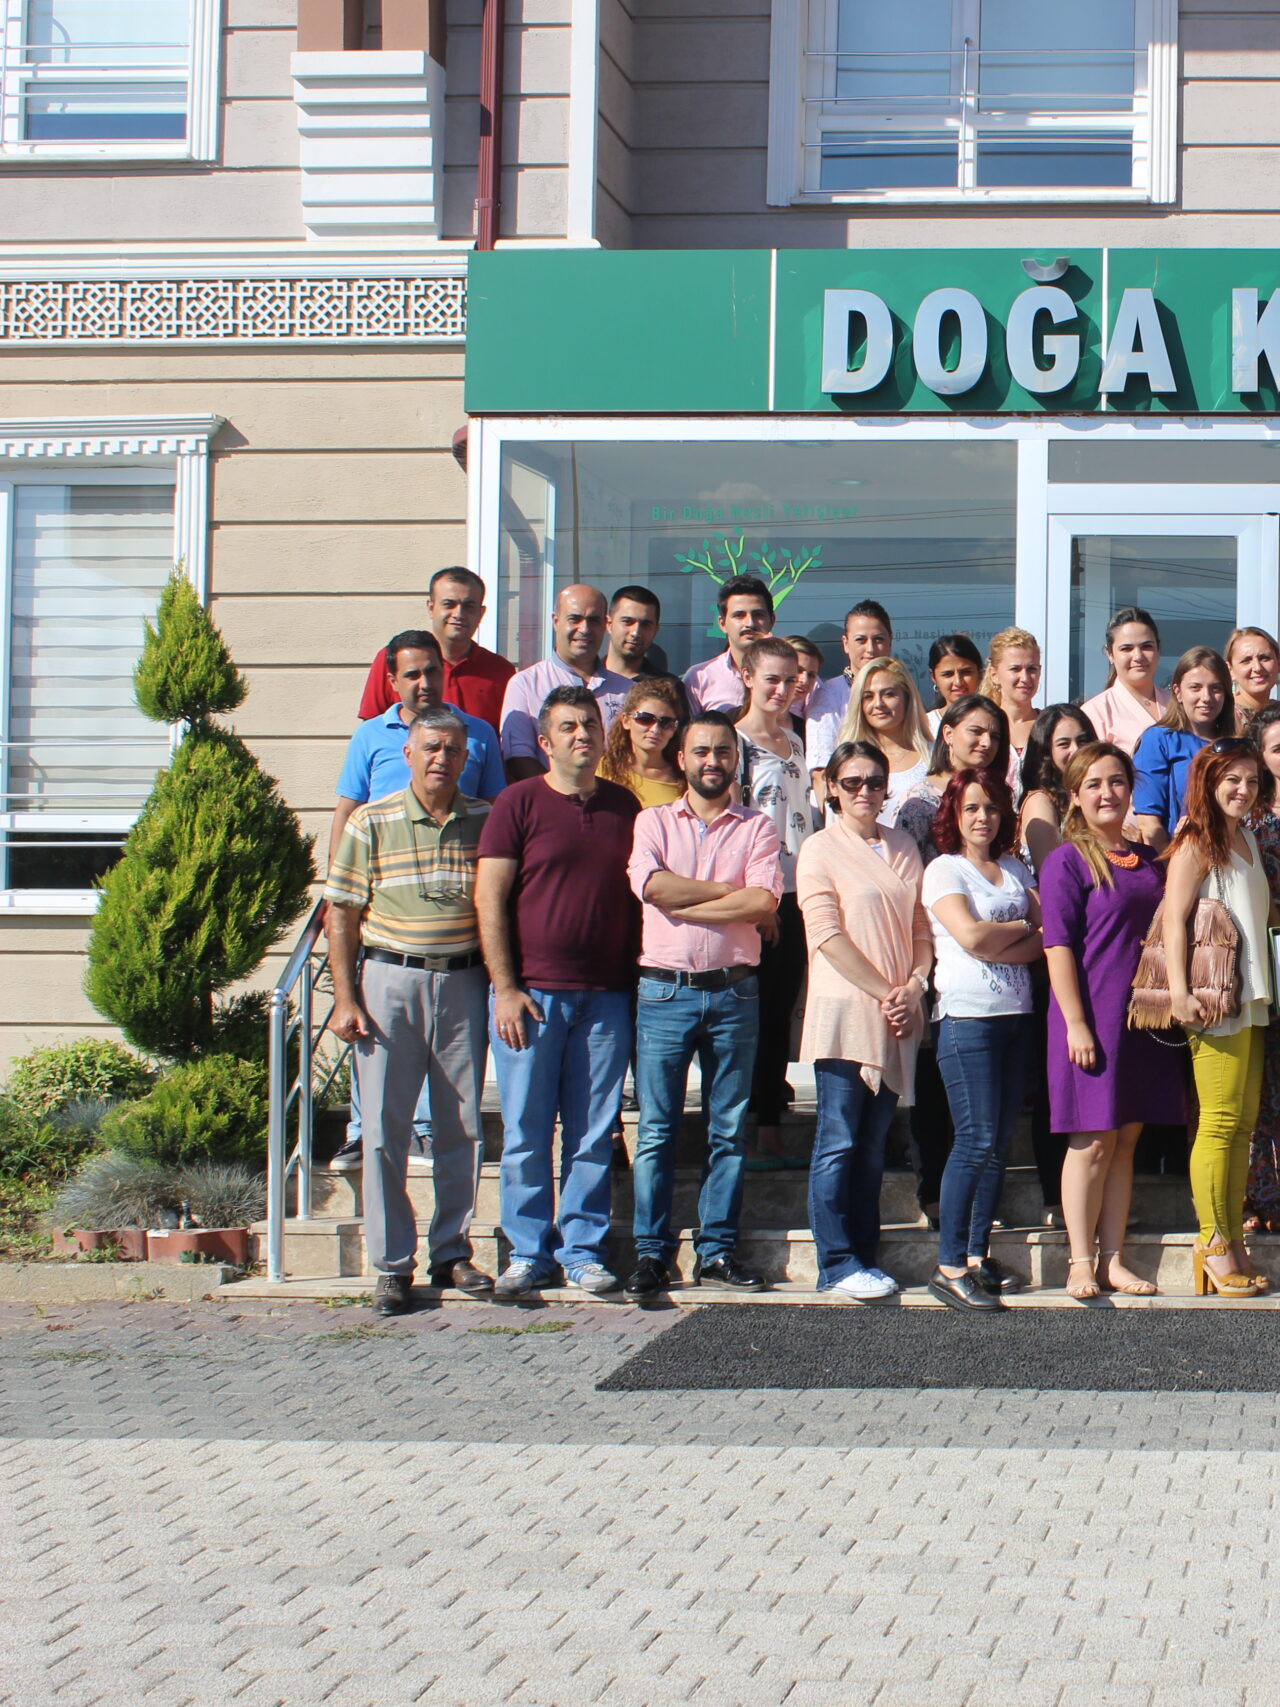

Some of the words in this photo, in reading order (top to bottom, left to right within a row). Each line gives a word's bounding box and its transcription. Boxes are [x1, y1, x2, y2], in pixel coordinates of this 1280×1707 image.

[821, 256, 1178, 395] DOĞA
[652, 506, 675, 521] Bir
[683, 505, 723, 523] Doğa
